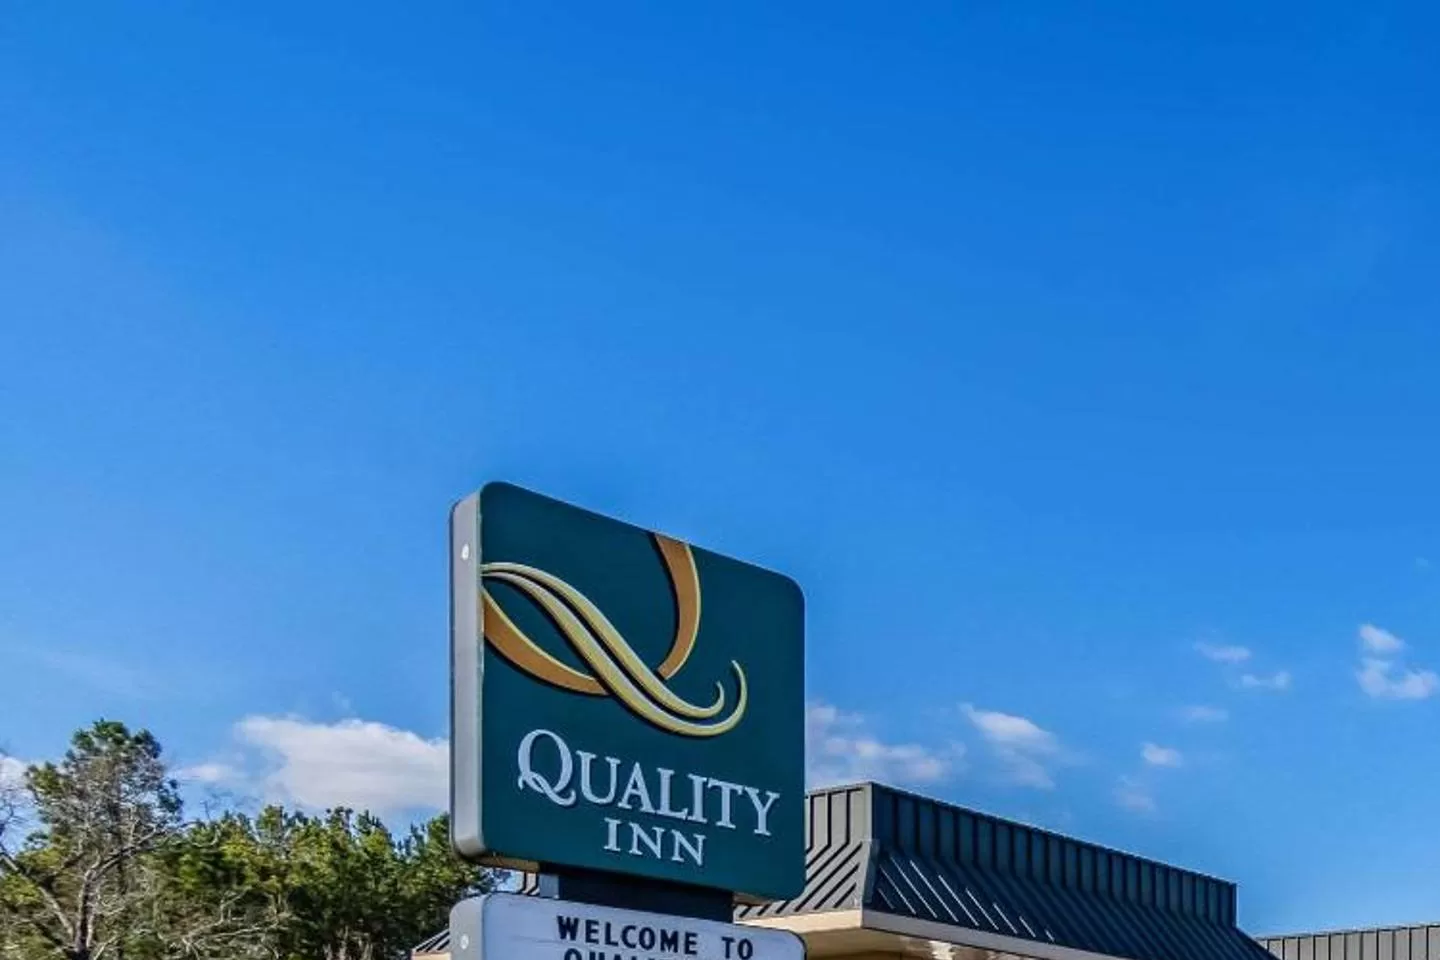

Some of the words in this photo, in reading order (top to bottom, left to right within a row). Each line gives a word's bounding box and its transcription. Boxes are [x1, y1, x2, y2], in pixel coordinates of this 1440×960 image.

[516, 728, 780, 836] QUALITY
[604, 817, 706, 866] INN
[557, 915, 698, 956] WELCOME
[722, 935, 754, 960] TO
